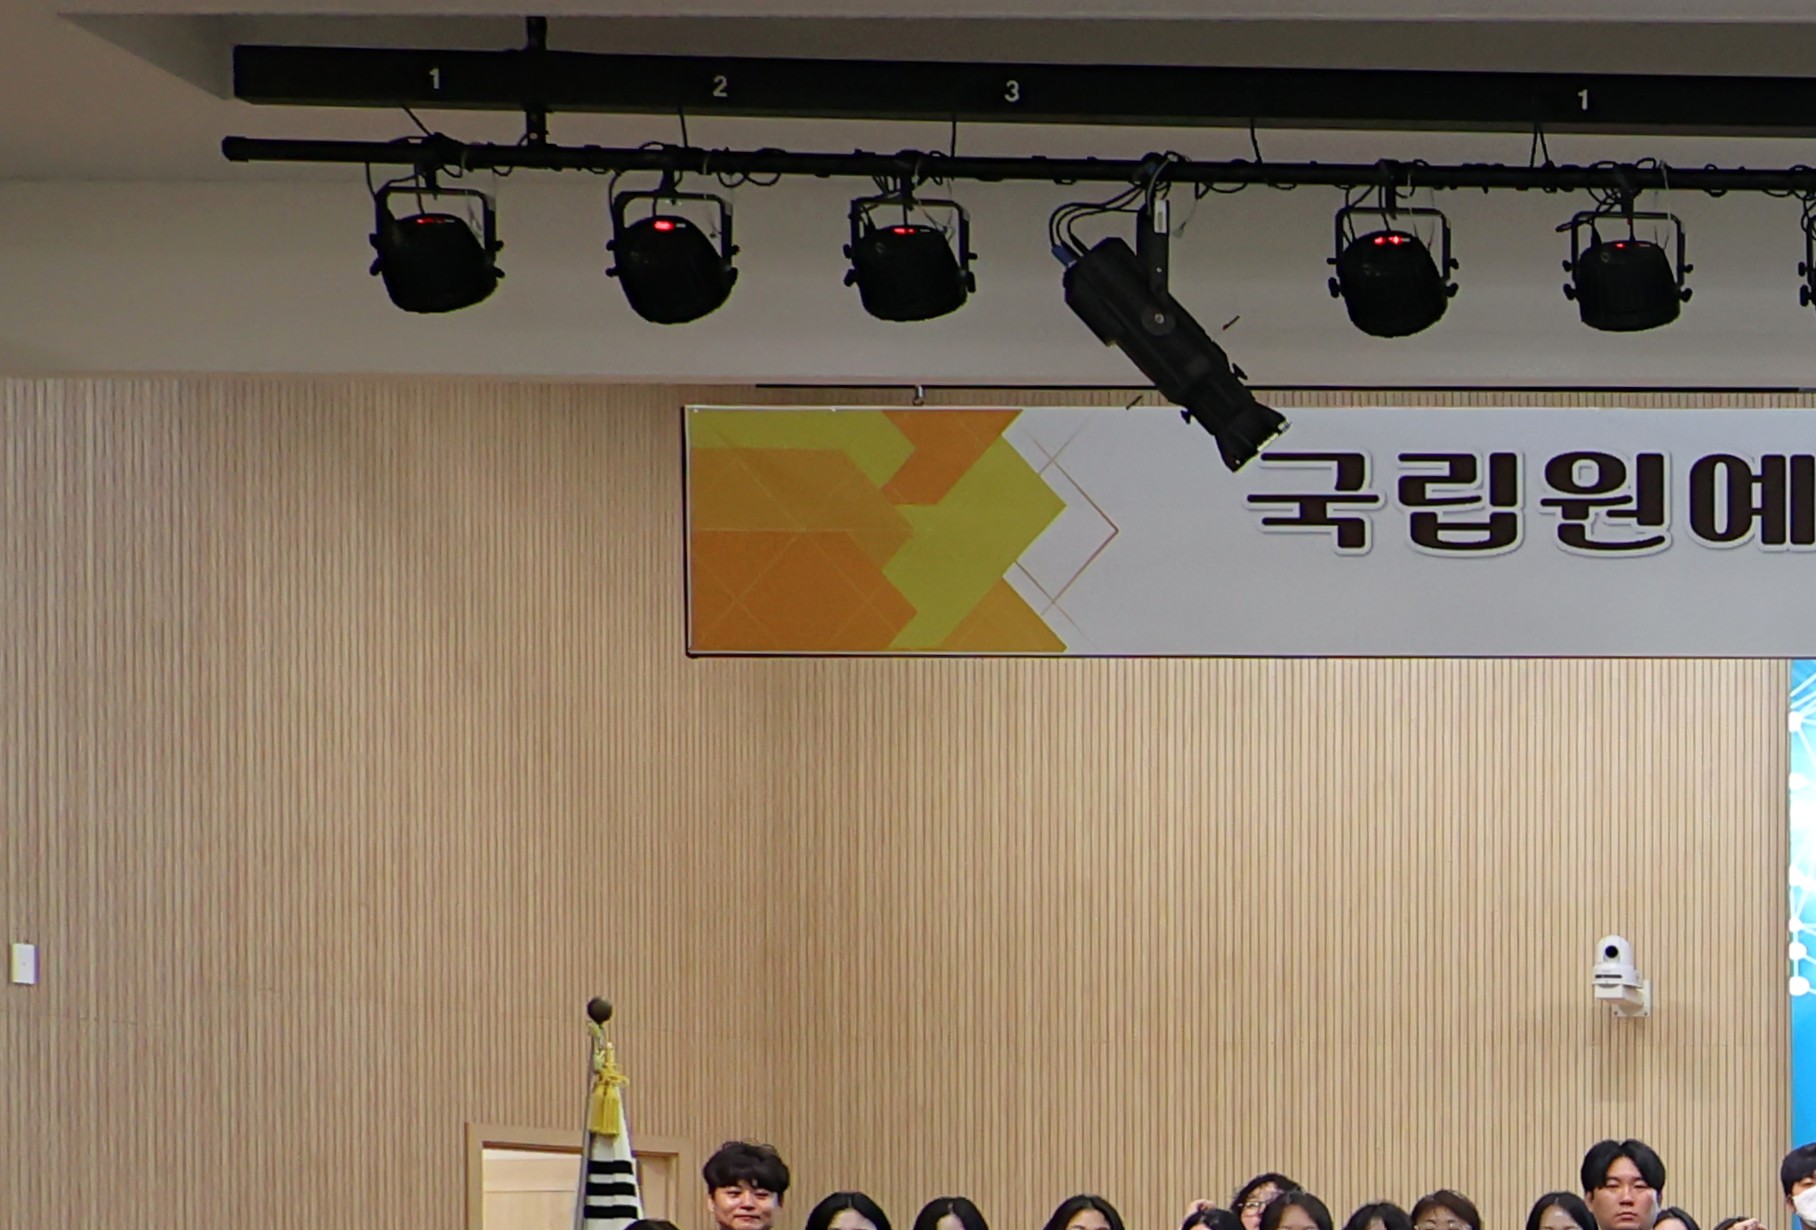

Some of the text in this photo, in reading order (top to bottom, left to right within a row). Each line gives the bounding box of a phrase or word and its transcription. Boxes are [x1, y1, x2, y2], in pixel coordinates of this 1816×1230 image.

[430, 69, 438, 89] 1
[714, 77, 727, 97] 2
[1005, 80, 1019, 102] 3
[1578, 90, 1587, 110] 1
